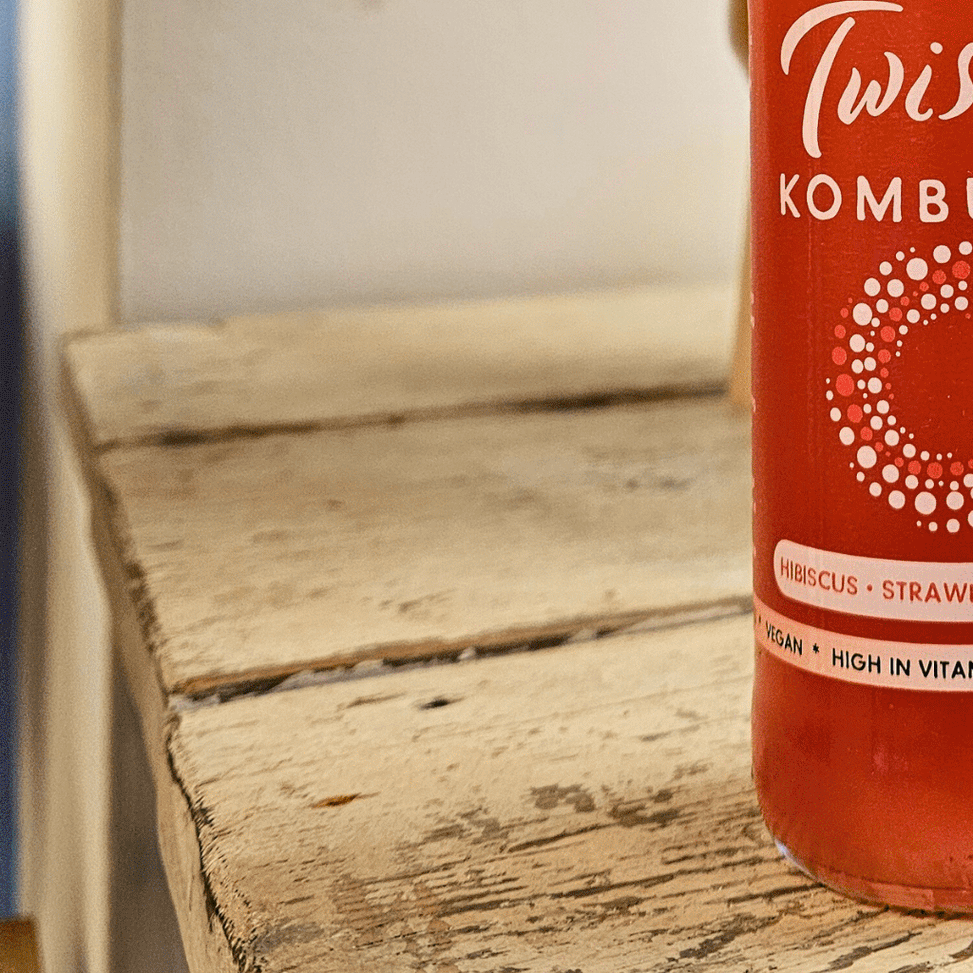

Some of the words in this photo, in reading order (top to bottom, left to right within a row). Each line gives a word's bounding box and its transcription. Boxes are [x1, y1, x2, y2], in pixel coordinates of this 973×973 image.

[780, 556, 858, 595] HIBISCUS
[765, 620, 803, 656] VEGAN
[832, 648, 881, 674] HIGH
[890, 657, 911, 677] IN
